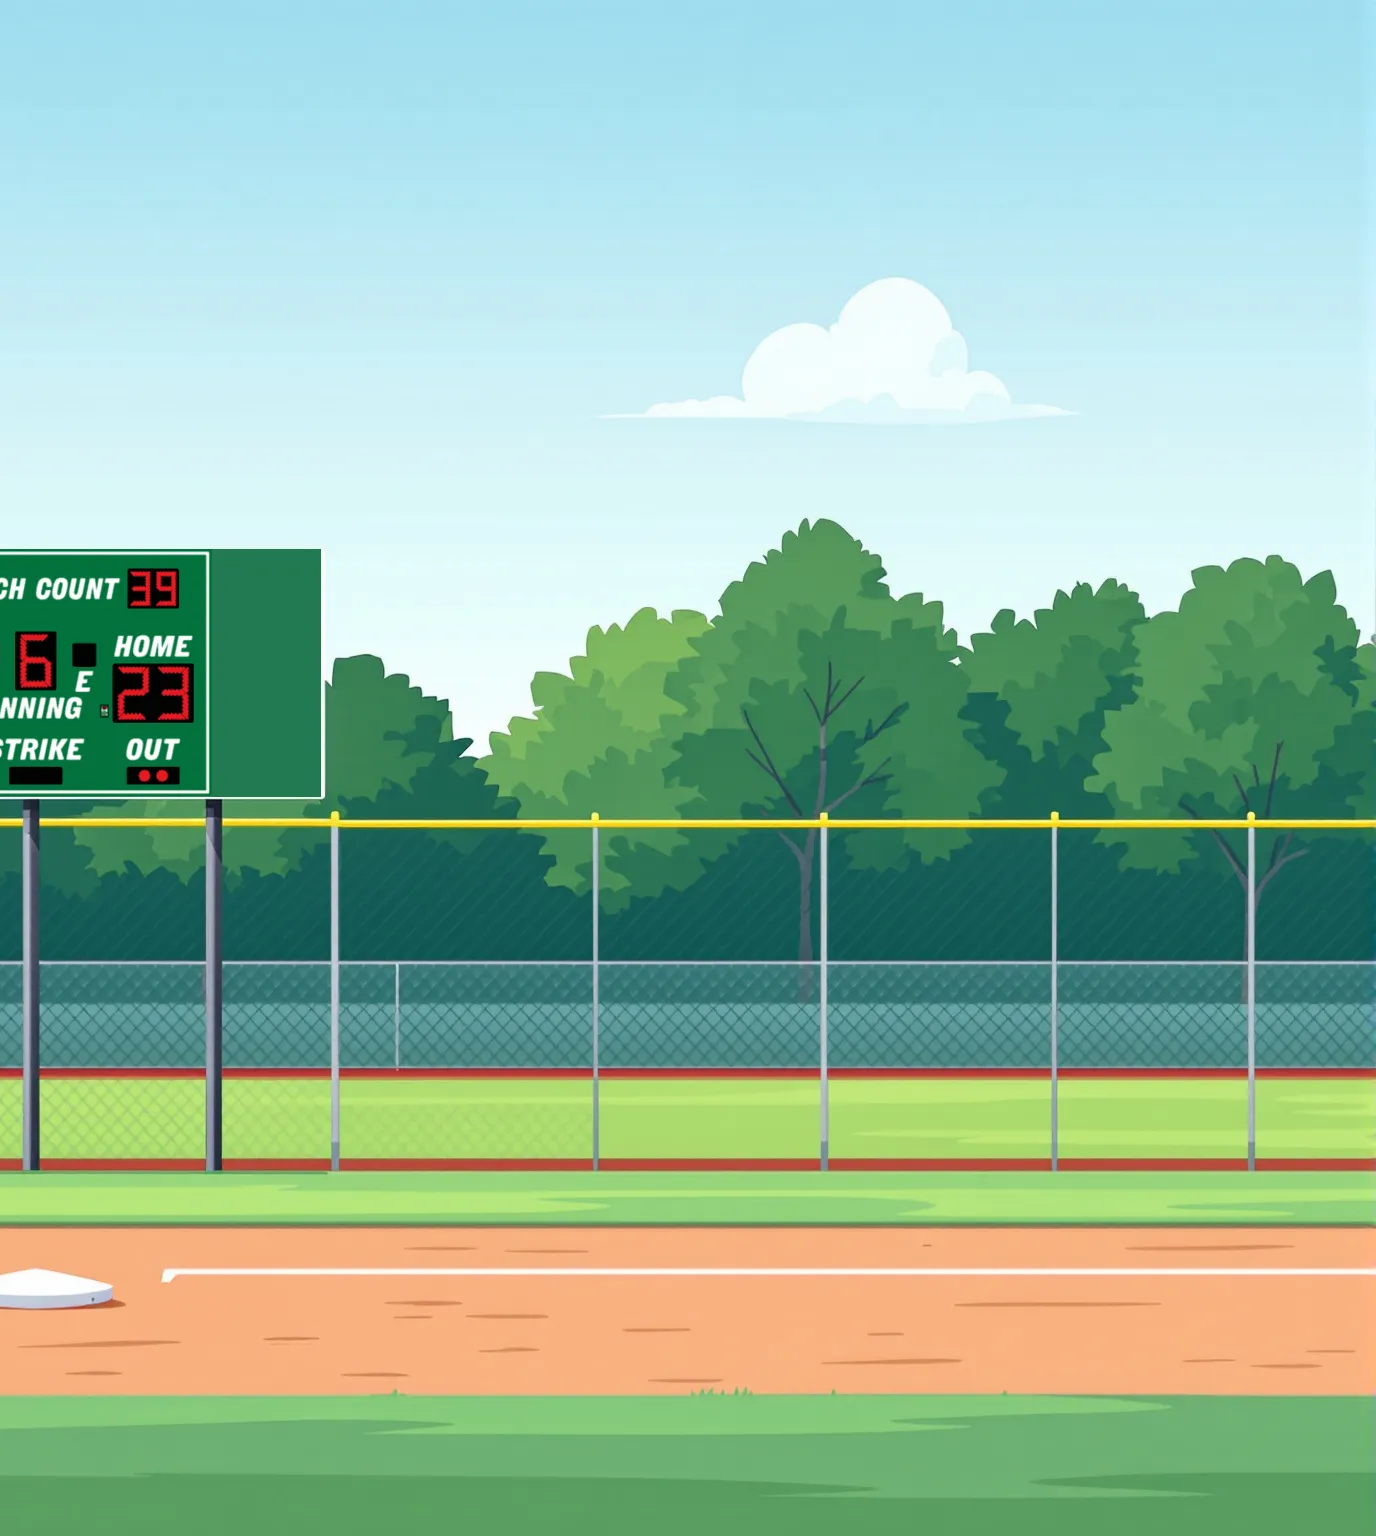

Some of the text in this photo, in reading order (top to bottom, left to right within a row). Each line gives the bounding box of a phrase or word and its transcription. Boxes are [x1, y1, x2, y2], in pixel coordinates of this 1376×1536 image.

[36, 578, 120, 600] COUNT
[131, 572, 176, 606] 39
[114, 635, 192, 657] HOME
[20, 634, 51, 687] 6
[76, 671, 93, 692] E
[118, 667, 189, 720] 23
[127, 738, 180, 760] OUT
